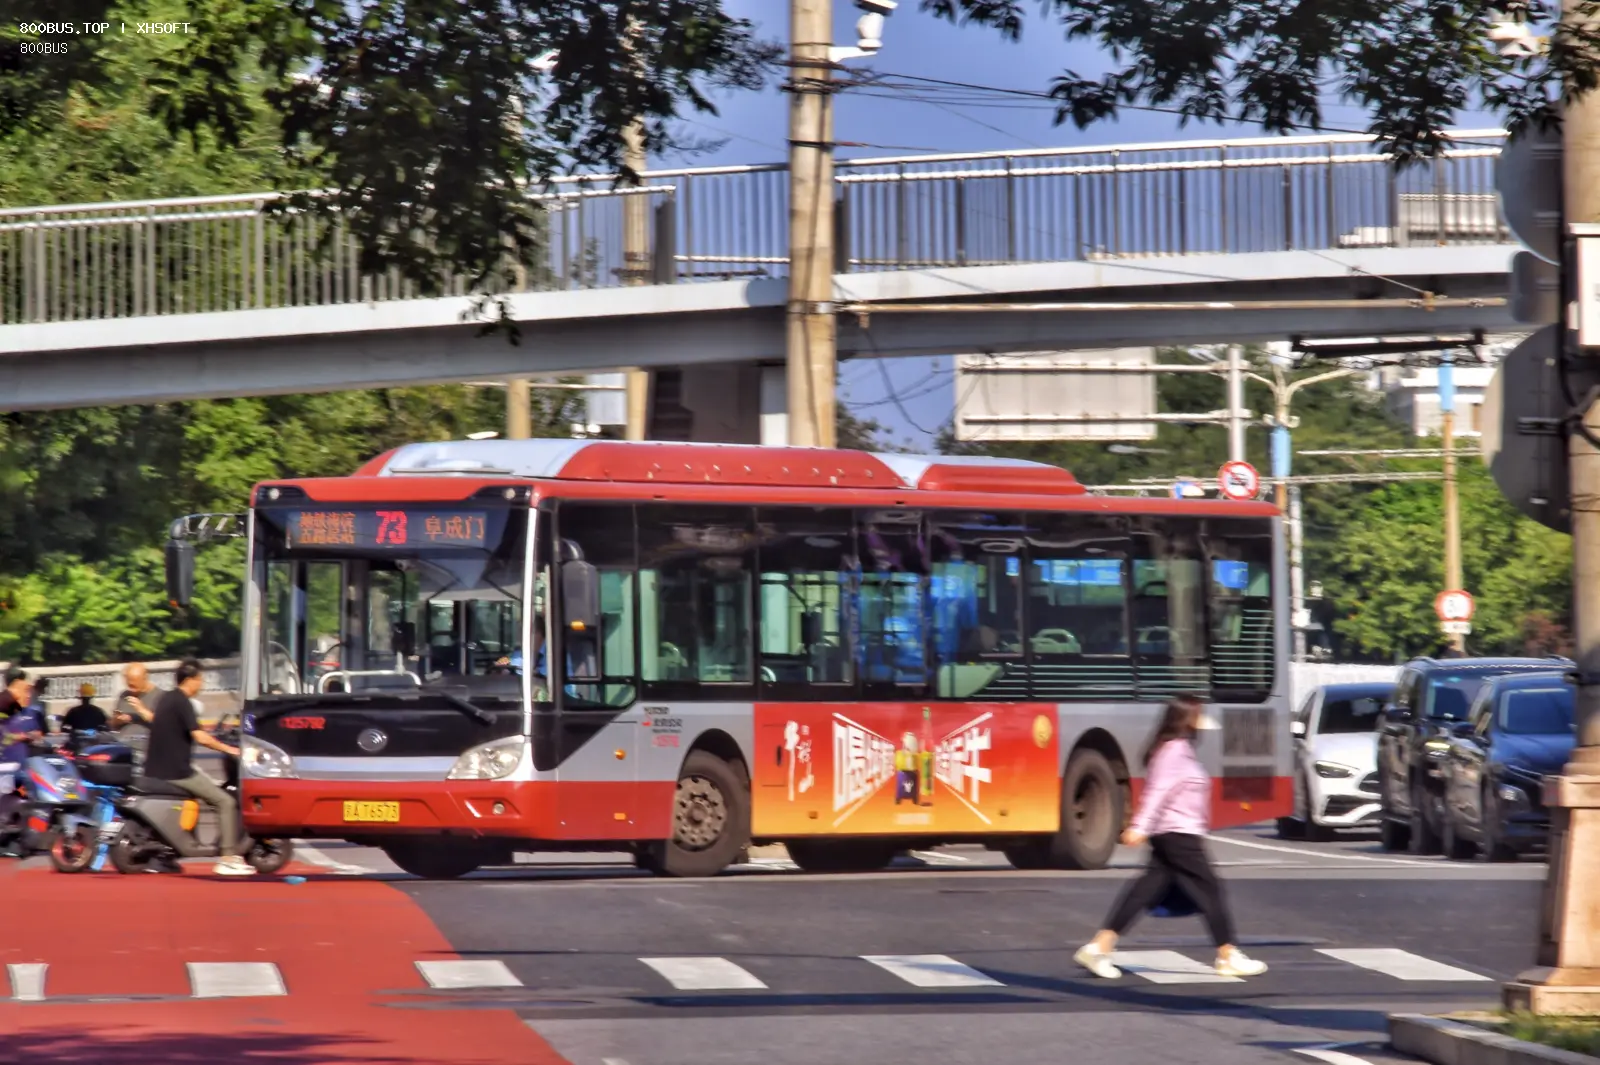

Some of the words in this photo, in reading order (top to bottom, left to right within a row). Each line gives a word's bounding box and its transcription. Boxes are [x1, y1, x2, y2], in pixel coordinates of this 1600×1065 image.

[375, 510, 408, 545] 73
[424, 514, 485, 541] 阜成门
